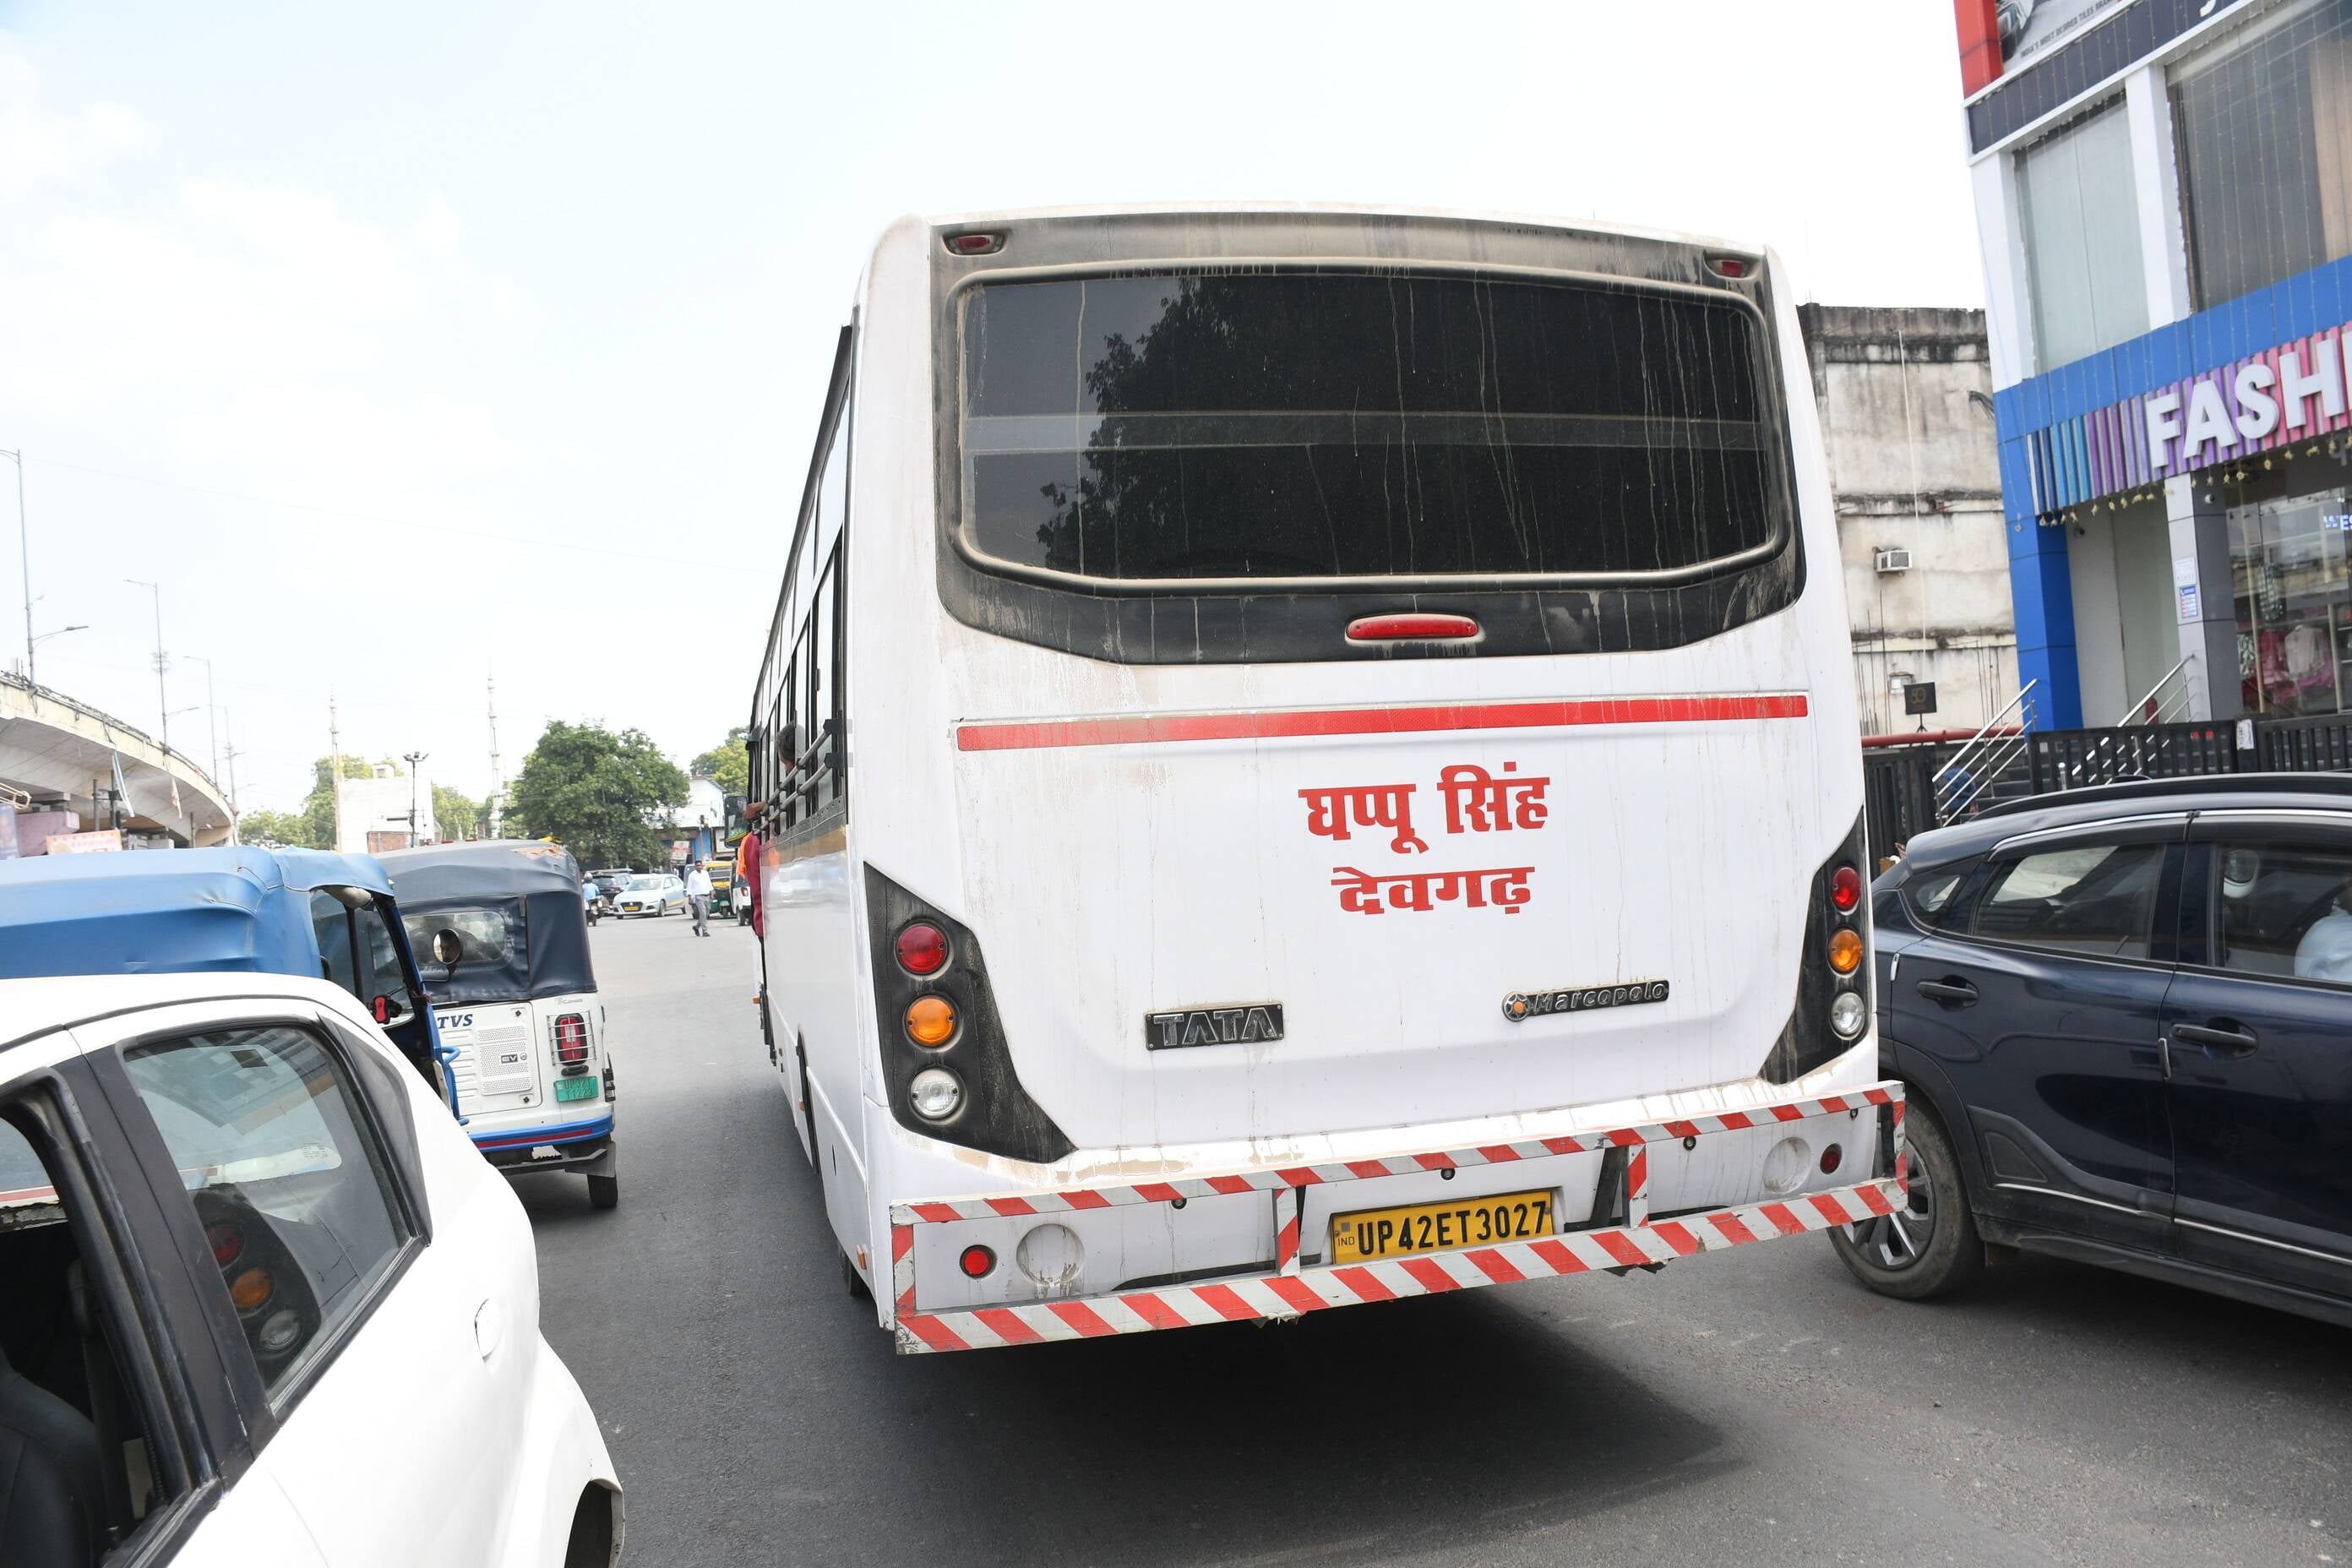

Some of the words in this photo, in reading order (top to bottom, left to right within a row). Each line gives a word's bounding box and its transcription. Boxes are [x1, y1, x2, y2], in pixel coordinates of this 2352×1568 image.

[2078, 6, 2093, 21] TILES
[1436, 761, 1550, 834] सिंह
[1331, 866, 1535, 915] देवगढ़
[1533, 981, 1667, 1015] Marcopolo
[437, 1014, 473, 1029] TVS
[1153, 1007, 1277, 1046] TATA
[1337, 1236, 1355, 1247] IND
[1357, 1200, 1547, 1255] UP42ET3027
